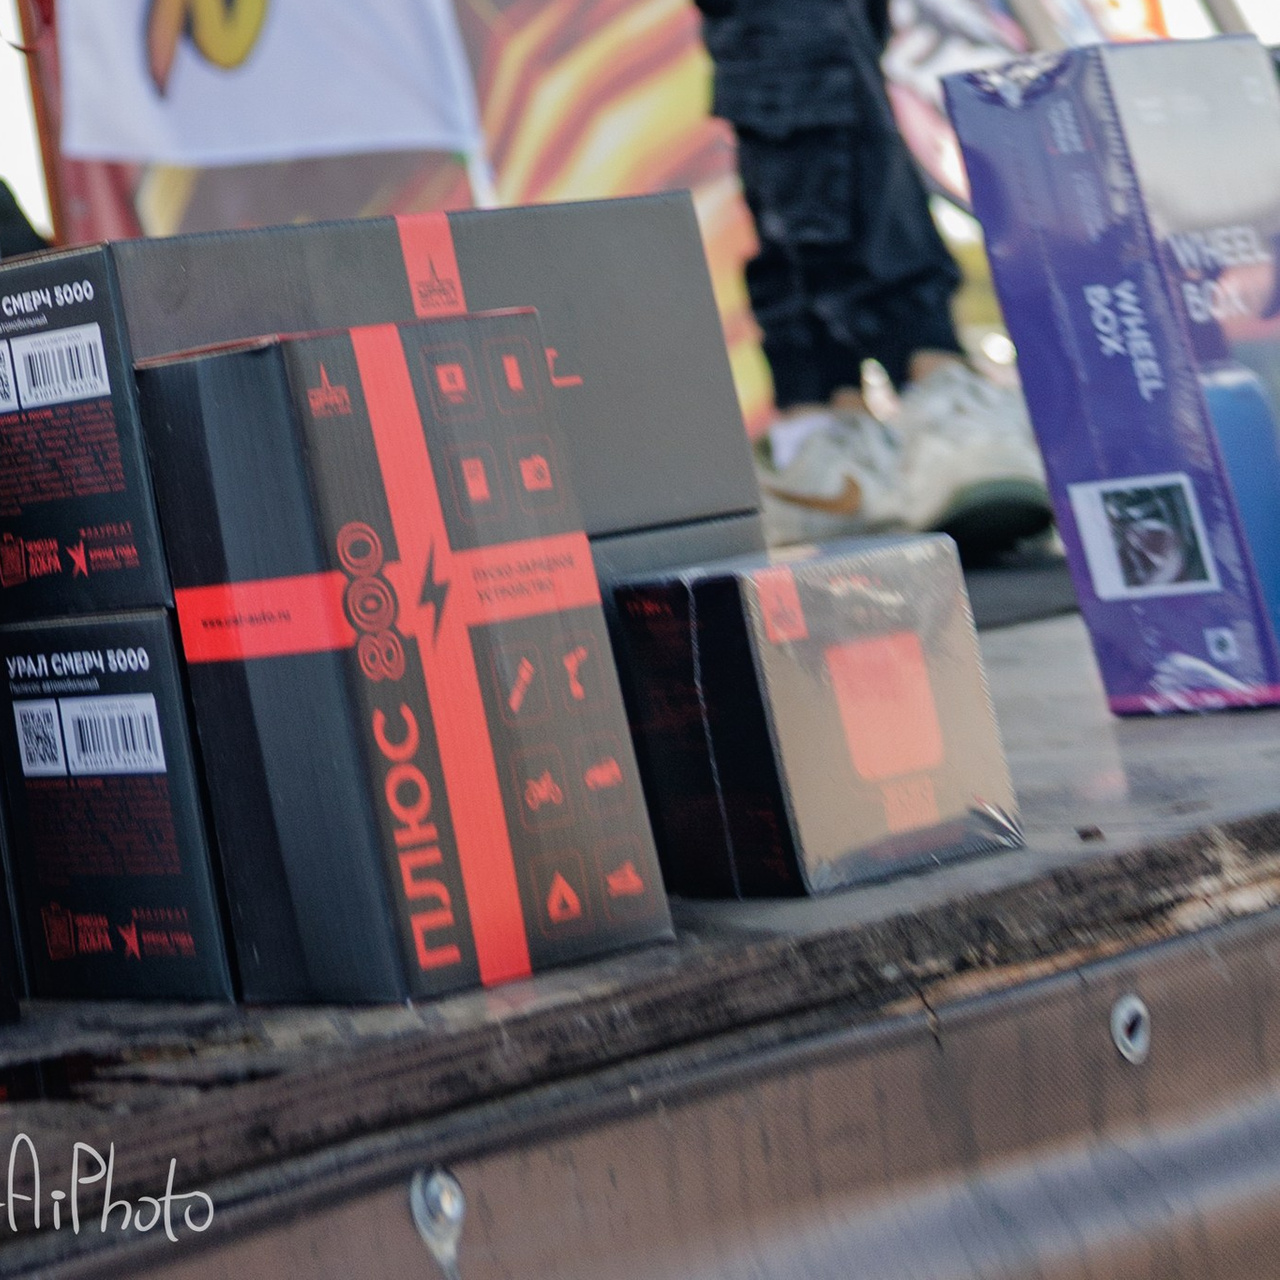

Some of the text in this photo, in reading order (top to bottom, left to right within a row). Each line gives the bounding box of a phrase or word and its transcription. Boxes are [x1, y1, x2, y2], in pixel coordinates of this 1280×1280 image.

[1171, 226, 1269, 272] WHEEL
[1, 287, 53, 317] СМЕРЧ
[53, 279, 95, 307] 5000
[1082, 283, 1126, 357] BOX
[1113, 279, 1167, 403] WHEEL
[6, 646, 150, 679] УРАЛ СМЕРЧ 5000
[336, 520, 462, 971] ПЛЮС 800
